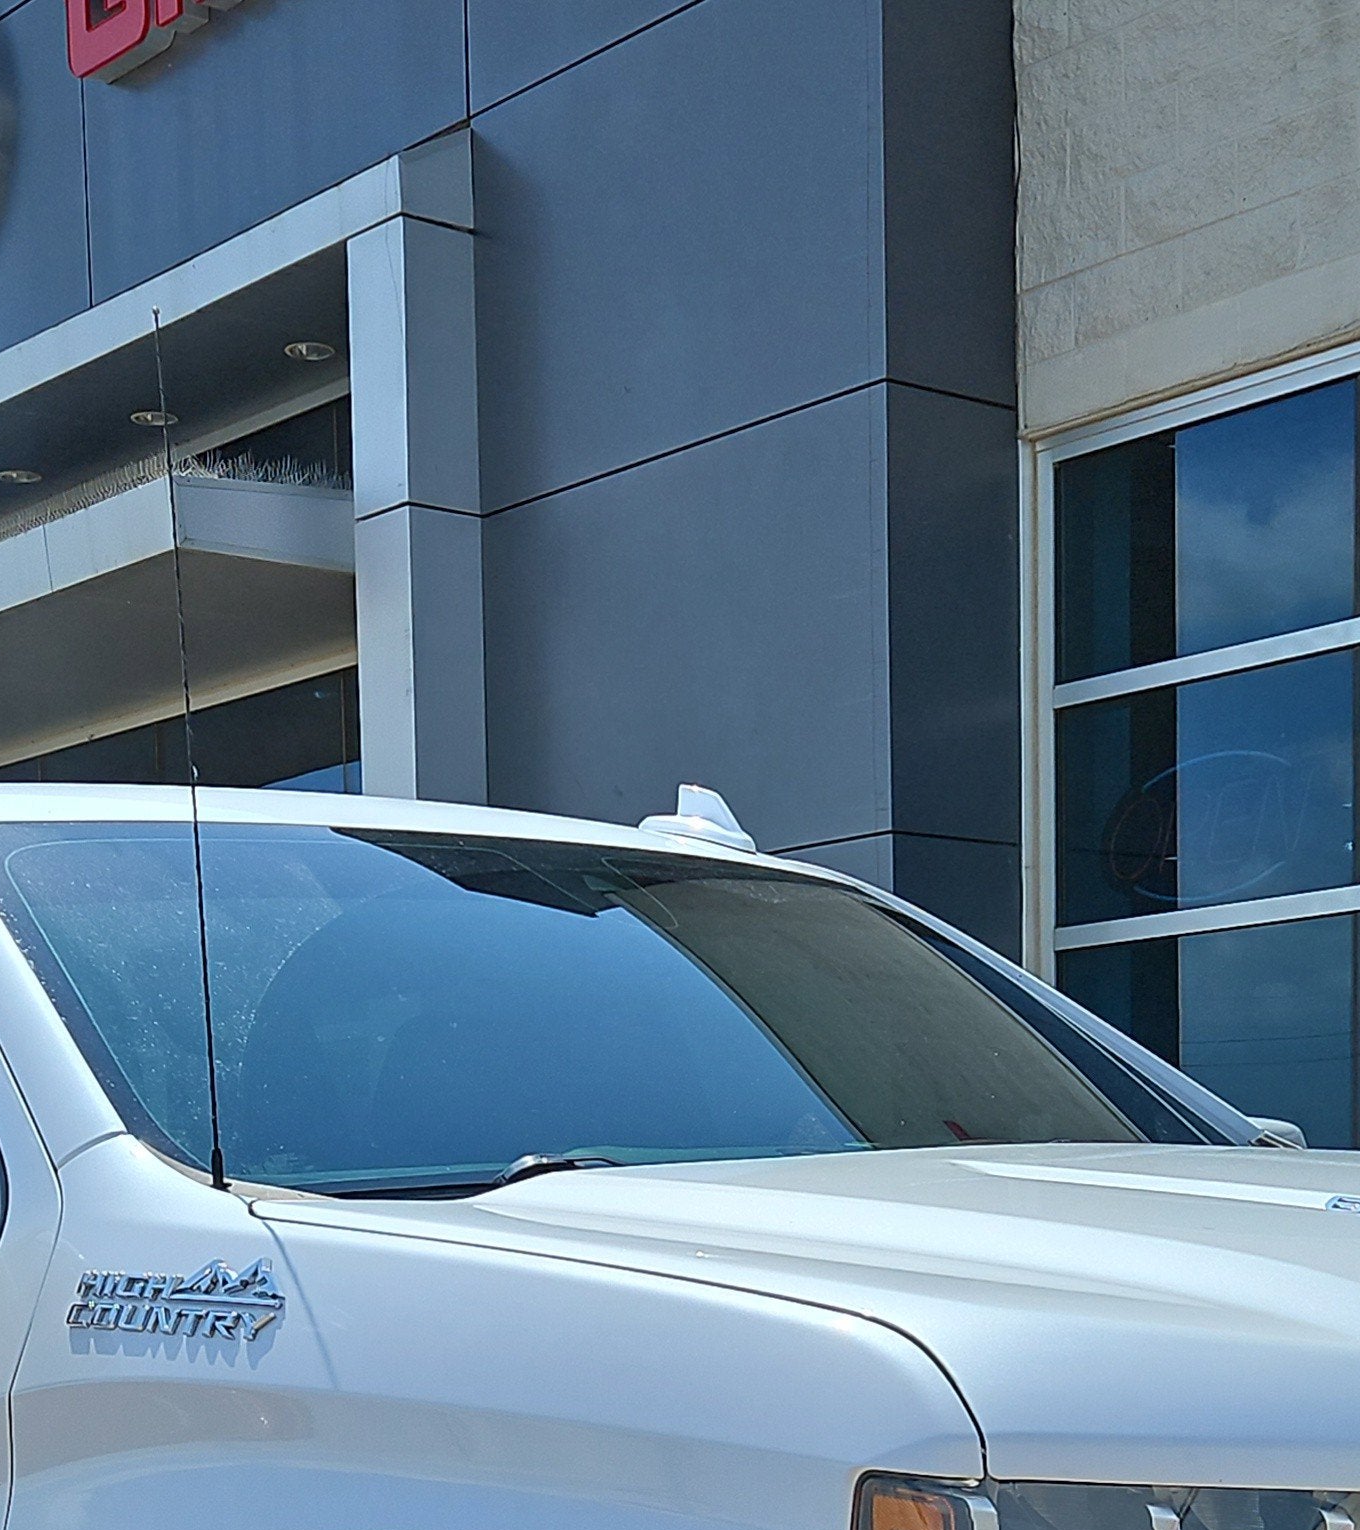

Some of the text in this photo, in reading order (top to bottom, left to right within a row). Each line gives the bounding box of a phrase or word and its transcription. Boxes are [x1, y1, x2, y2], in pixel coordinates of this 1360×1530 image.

[1109, 764, 1316, 880] OPEN
[75, 1268, 184, 1300] HIGH
[66, 1301, 277, 1341] COUNTRY
